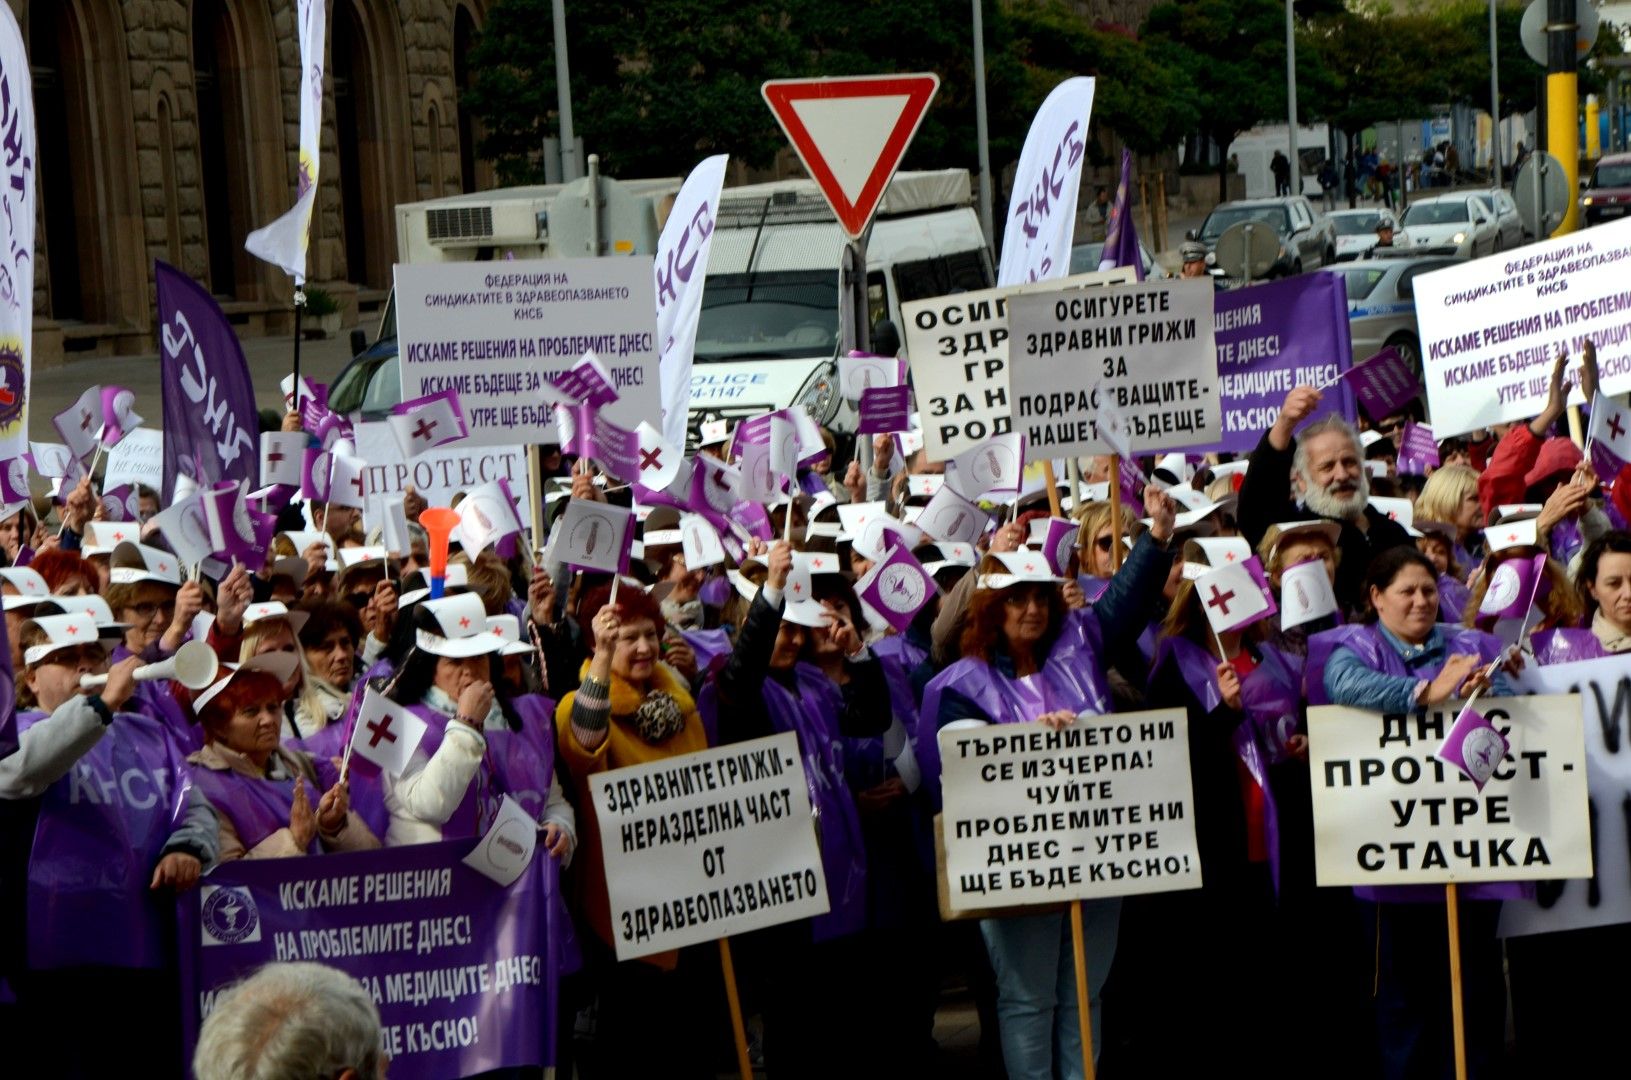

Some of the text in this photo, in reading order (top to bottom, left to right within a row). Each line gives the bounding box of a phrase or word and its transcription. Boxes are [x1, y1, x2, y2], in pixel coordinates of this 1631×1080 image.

[1015, 119, 1084, 243] КНСБ
[656, 200, 713, 310] НСБ
[1505, 241, 1593, 275] ФЕДЕРАЦИЯ НА
[485, 272, 568, 288] ФЕДЕРАЦИЯ НА
[1444, 245, 1631, 307] СИНДИКАТИТЕ В ЗДРАВЕОПАЗВА
[1536, 279, 1568, 298] КНСБ
[425, 287, 629, 308] СИНДИКАТИТЕ В ЗДРАВЕОПАЗВАНЕТО
[1056, 291, 1169, 322] ОСИГУРЕТЕ
[514, 308, 543, 321] КНСБ
[915, 298, 1007, 330] ОСИГ
[1215, 304, 1261, 332] ШЕНИЯ
[1429, 290, 1631, 361] ИСКАМЕ РЕШЕНИЯ НА ПРОБЛЕМИ
[407, 333, 652, 363] ИСКАМЕ РЕШЕНИЯ НА ПРОБЛЕМИТЕ ДНЕС!
[938, 328, 1008, 357] ЗДР
[1027, 319, 1196, 356] ЗДРАВНИ ГРИЖИ
[1238, 335, 1279, 364] ДНЕС!
[690, 373, 768, 385] OLICE
[964, 360, 1004, 382] ГР
[1103, 356, 1127, 378] ЗА
[1294, 364, 1338, 389] ДНЕС!
[1444, 361, 1496, 388] ИСКАМЕ
[1499, 344, 1550, 374] БЪДЕЩЕ
[1553, 339, 1569, 359] ЗА
[421, 375, 471, 396] ИСКАМЕ
[474, 372, 523, 396] БЪДЕЩЕ
[526, 371, 540, 391] ЗА
[1497, 381, 1527, 404] УТРЕ
[1529, 376, 1549, 398] ЩЕ
[470, 405, 552, 428] УТРЕ ЩЕ БЪДЕ
[930, 394, 974, 417] ЗА
[985, 388, 1007, 409] Н
[940, 416, 1011, 444] РОД
[1029, 422, 1099, 447] НАШЕТ
[369, 453, 517, 494] ПРОТЕСТ
[957, 721, 1175, 758] ТЪРПЕНИЕТО НИ
[1379, 708, 1512, 748] ДНС
[605, 761, 716, 815] ЗДРАВНИТЕ
[718, 747, 783, 787] ГРИЖИ
[981, 750, 1154, 782] СЕ ИЗЧЕРПА!
[1324, 752, 1547, 788] ПРОТСТ
[1027, 779, 1113, 805] ЧУЙТЕ
[622, 788, 791, 853] НЕРАЗДЕЛНА ЧАСТ
[956, 802, 1184, 839] ПРОБЛЕМИТЕ НИ
[1391, 796, 1511, 828] УТРЕ
[703, 846, 726, 878] ОТ
[987, 840, 1060, 867] ДНЕС
[1096, 831, 1159, 855] УТРЕ
[1357, 837, 1551, 872] СТАЧКА
[279, 868, 452, 910] ИСКАМЕ РЕШЕНИЯ
[961, 855, 1190, 895] ЩЕ БЪДЕ КЪСНО!
[621, 868, 817, 944] ЗДРАВЕОПАЗВАНЕТО
[274, 916, 472, 961] НА ПРОБЛЕМИТЕ ДНЕС!
[385, 963, 490, 1007] МЕДИЦИТЕ
[495, 955, 540, 994] ДНЕС!
[381, 1016, 478, 1061] ДЕ КЪСНО!
